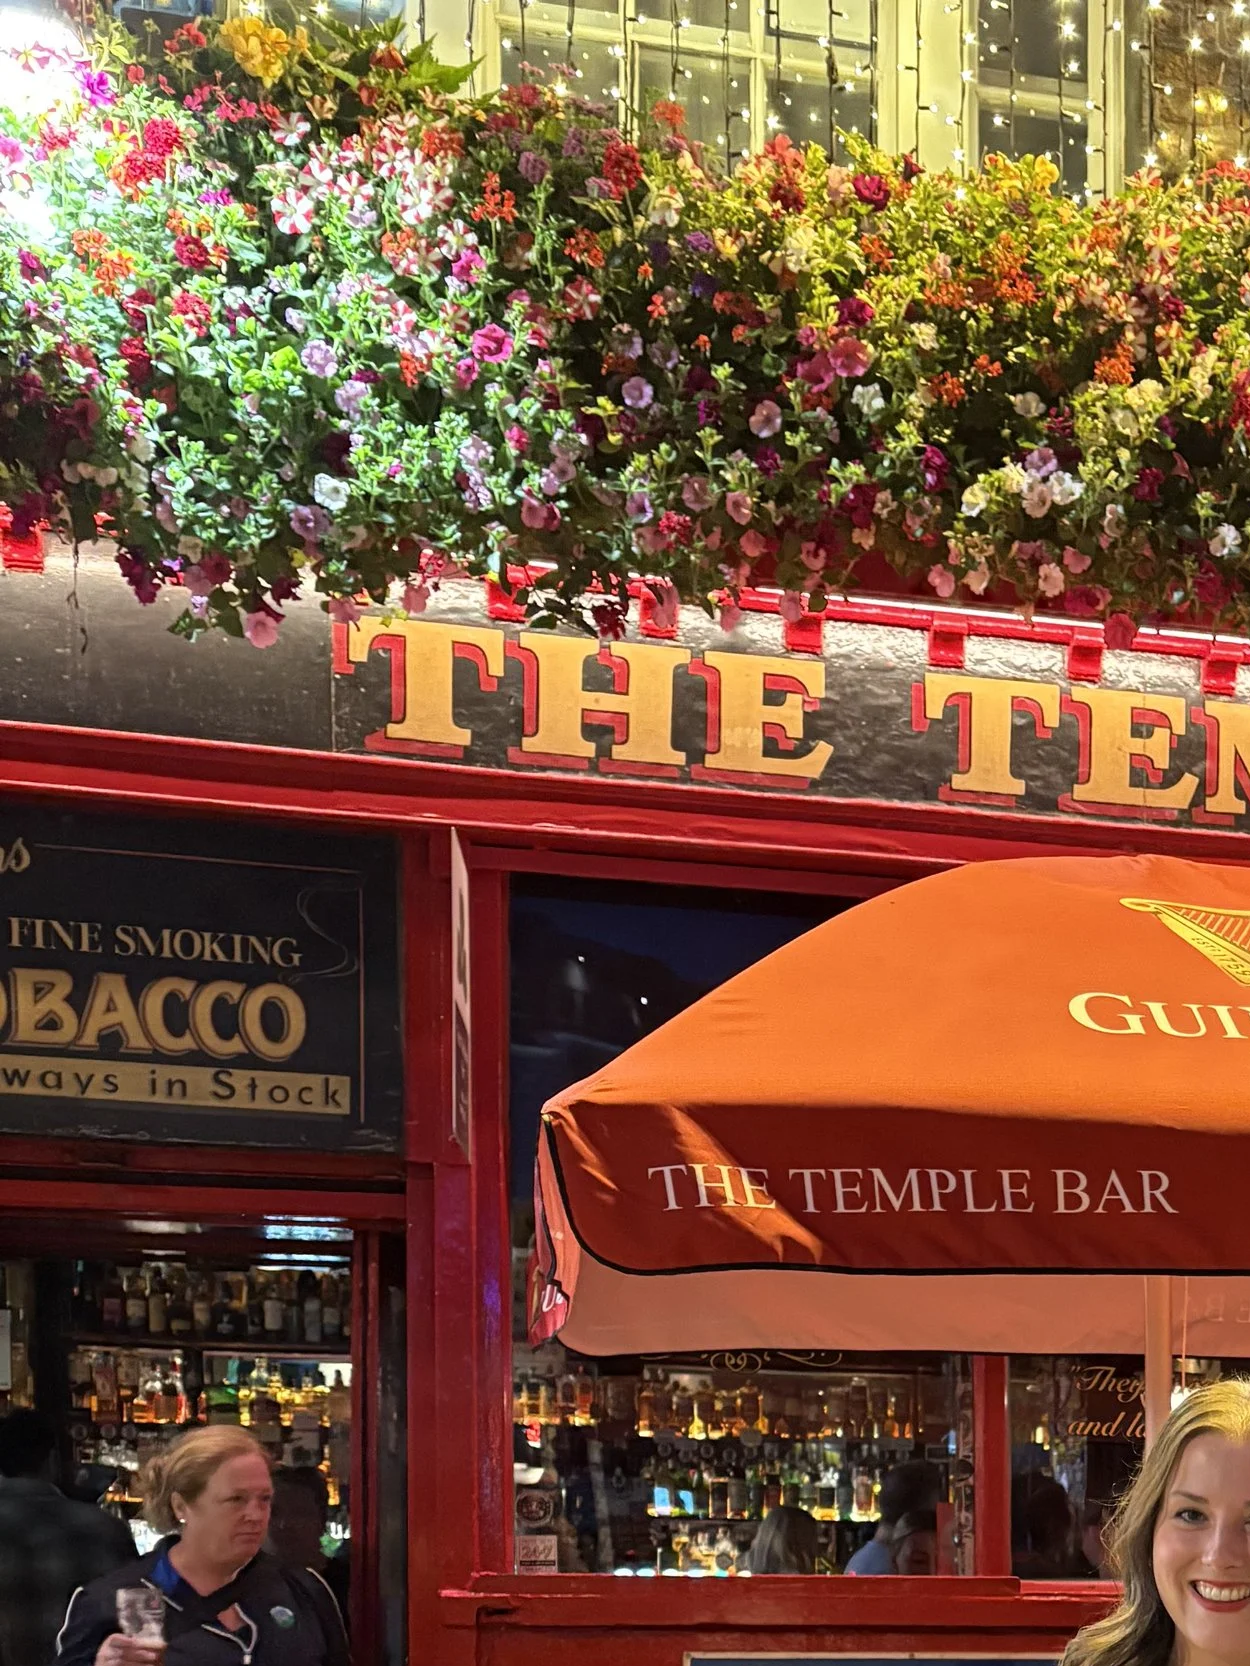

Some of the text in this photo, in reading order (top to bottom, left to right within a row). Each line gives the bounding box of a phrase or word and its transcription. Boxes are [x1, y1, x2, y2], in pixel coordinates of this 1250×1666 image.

[335, 614, 834, 790] THE
[8, 917, 303, 968] FINE SMOKING
[0, 967, 306, 1062] BACCO
[1, 1067, 342, 1109] ways in Stock
[648, 1163, 1180, 1214] THE TEMPLE BAR
[1067, 1411, 1126, 1437] and
